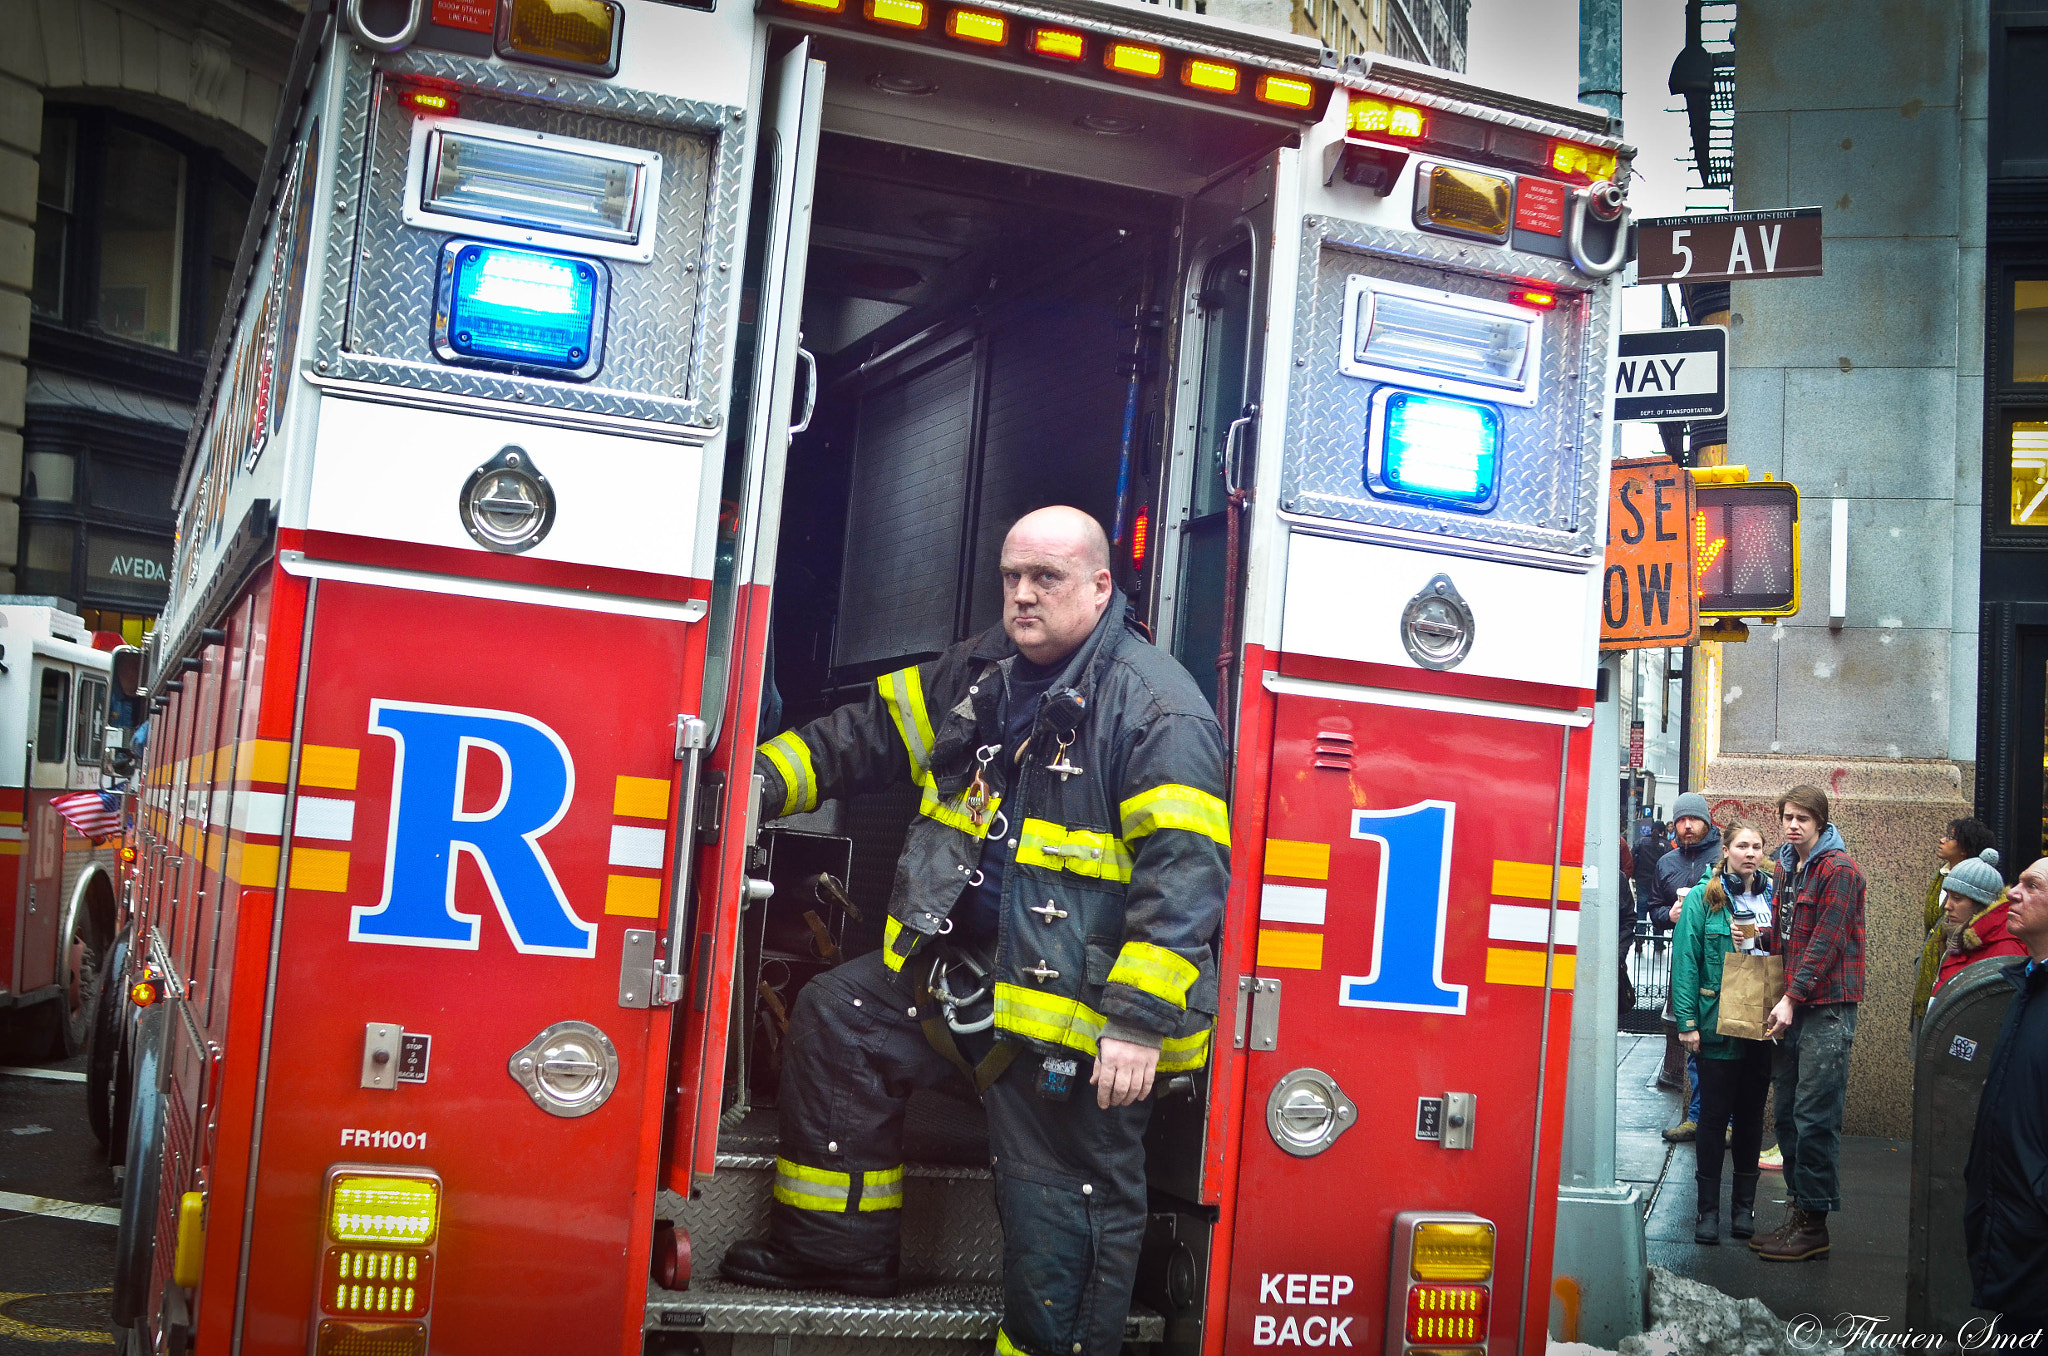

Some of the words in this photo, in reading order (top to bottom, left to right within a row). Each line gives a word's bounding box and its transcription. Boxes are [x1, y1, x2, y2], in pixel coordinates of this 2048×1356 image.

[462, 5, 491, 17] STRAIGHT
[462, 15, 479, 24] PULL
[1656, 217, 1688, 227] LADIES
[1689, 215, 1712, 225] MILE
[1714, 213, 1756, 224] HISTORIC
[1757, 211, 1798, 220] DISTRICT
[1671, 229, 1693, 279] 5
[1726, 224, 1782, 275] AV
[1615, 358, 1686, 393] WAY
[1666, 407, 1713, 415] TRANSPORTATION
[1606, 478, 1678, 546] SE
[109, 555, 166, 582] AVEDA
[348, 697, 598, 959] R
[1338, 799, 1469, 1016] 1
[340, 1128, 427, 1150] FR11001
[1259, 1273, 1354, 1305] KEEP
[1253, 1315, 1354, 1347] BACK
